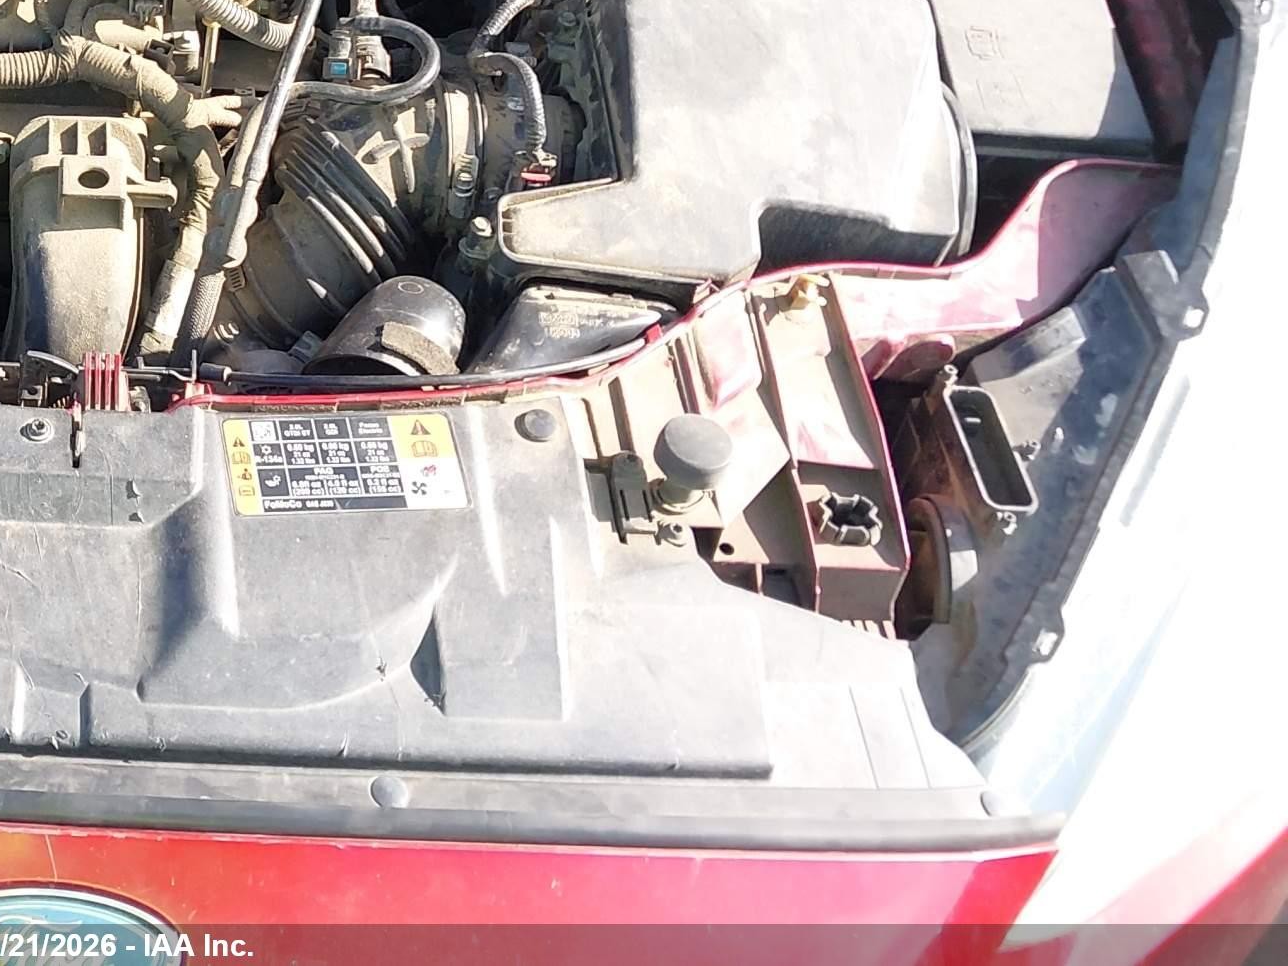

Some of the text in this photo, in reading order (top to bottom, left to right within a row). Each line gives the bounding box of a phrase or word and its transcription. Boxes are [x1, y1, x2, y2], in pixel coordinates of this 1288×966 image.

[338, 442, 349, 452] kg
[313, 466, 334, 475] PAG
[263, 499, 303, 509] FoMoCo
